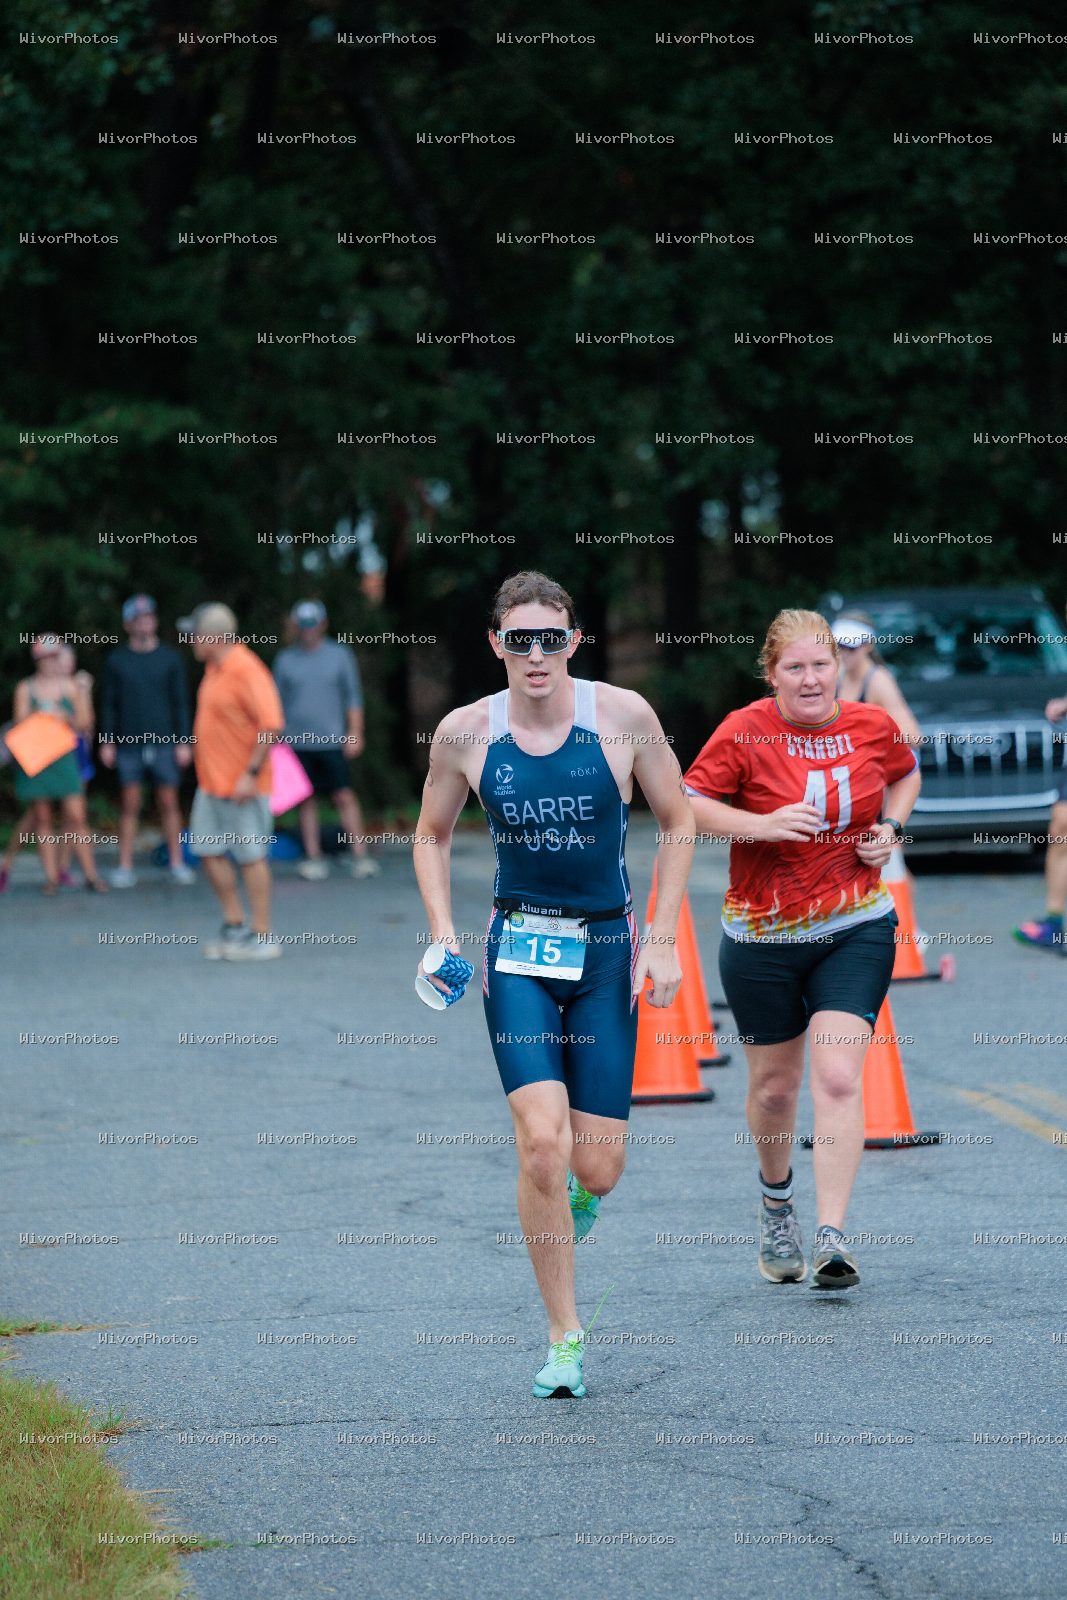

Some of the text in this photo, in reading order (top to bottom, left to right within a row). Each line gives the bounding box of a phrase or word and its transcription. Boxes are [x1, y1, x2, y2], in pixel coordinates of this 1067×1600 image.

[502, 796, 595, 826] BARRE
[803, 765, 853, 835] 41
[524, 827, 585, 852] USA
[526, 936, 562, 964] 15
